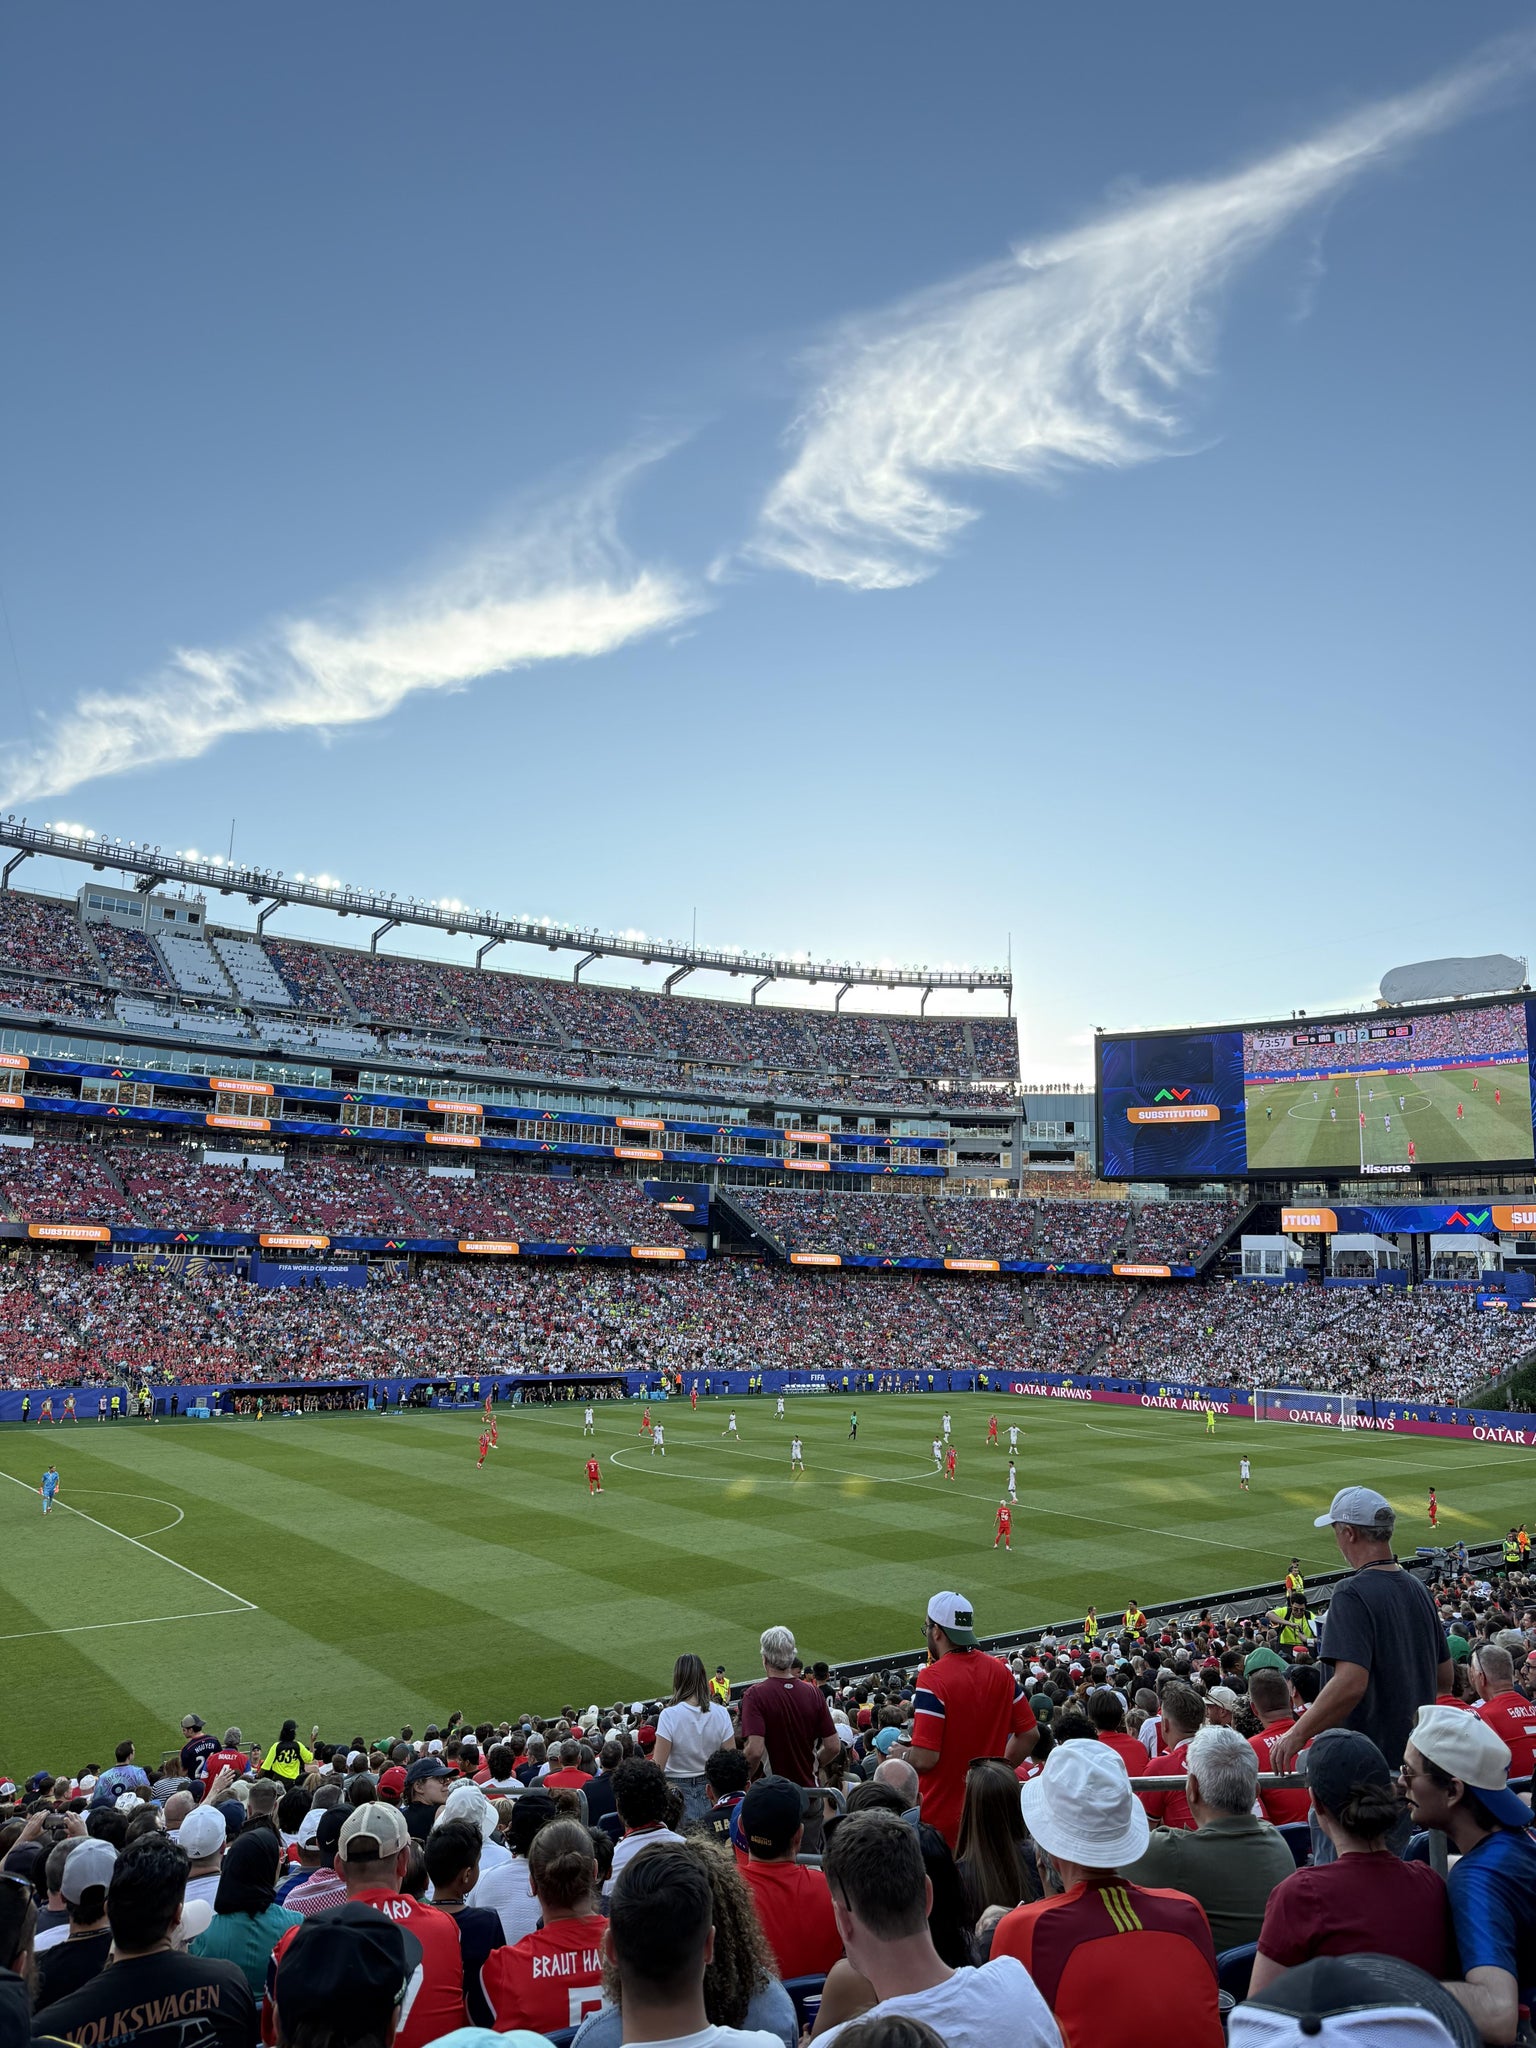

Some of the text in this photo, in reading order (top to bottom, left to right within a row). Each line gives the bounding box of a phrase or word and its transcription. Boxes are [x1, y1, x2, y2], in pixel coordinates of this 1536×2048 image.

[1258, 1038, 1286, 1048] 73:57
[1337, 1033, 1343, 1042] 1
[1360, 1031, 1366, 1040] 2
[218, 1081, 266, 1092] SUBSTITUTION
[1138, 1109, 1208, 1119] SUBSTITUTION
[1360, 1164, 1411, 1174] Hisense
[1511, 1211, 1536, 1224] SU
[39, 1228, 101, 1237] SUBSTITUTION
[268, 1237, 322, 1246] SUBSTITUTION
[1015, 1383, 1092, 1400] QATAR AIRWAYS
[1141, 1395, 1229, 1414] QATAR AIRWAYS
[1289, 1409, 1395, 1430] QATAR AIRWAYS
[1472, 1426, 1526, 1444] QATAR
[195, 1743, 215, 1754] NGUYEN
[533, 1951, 578, 1979] BRAUT
[66, 1984, 220, 2047] VOLKSWAGEN
